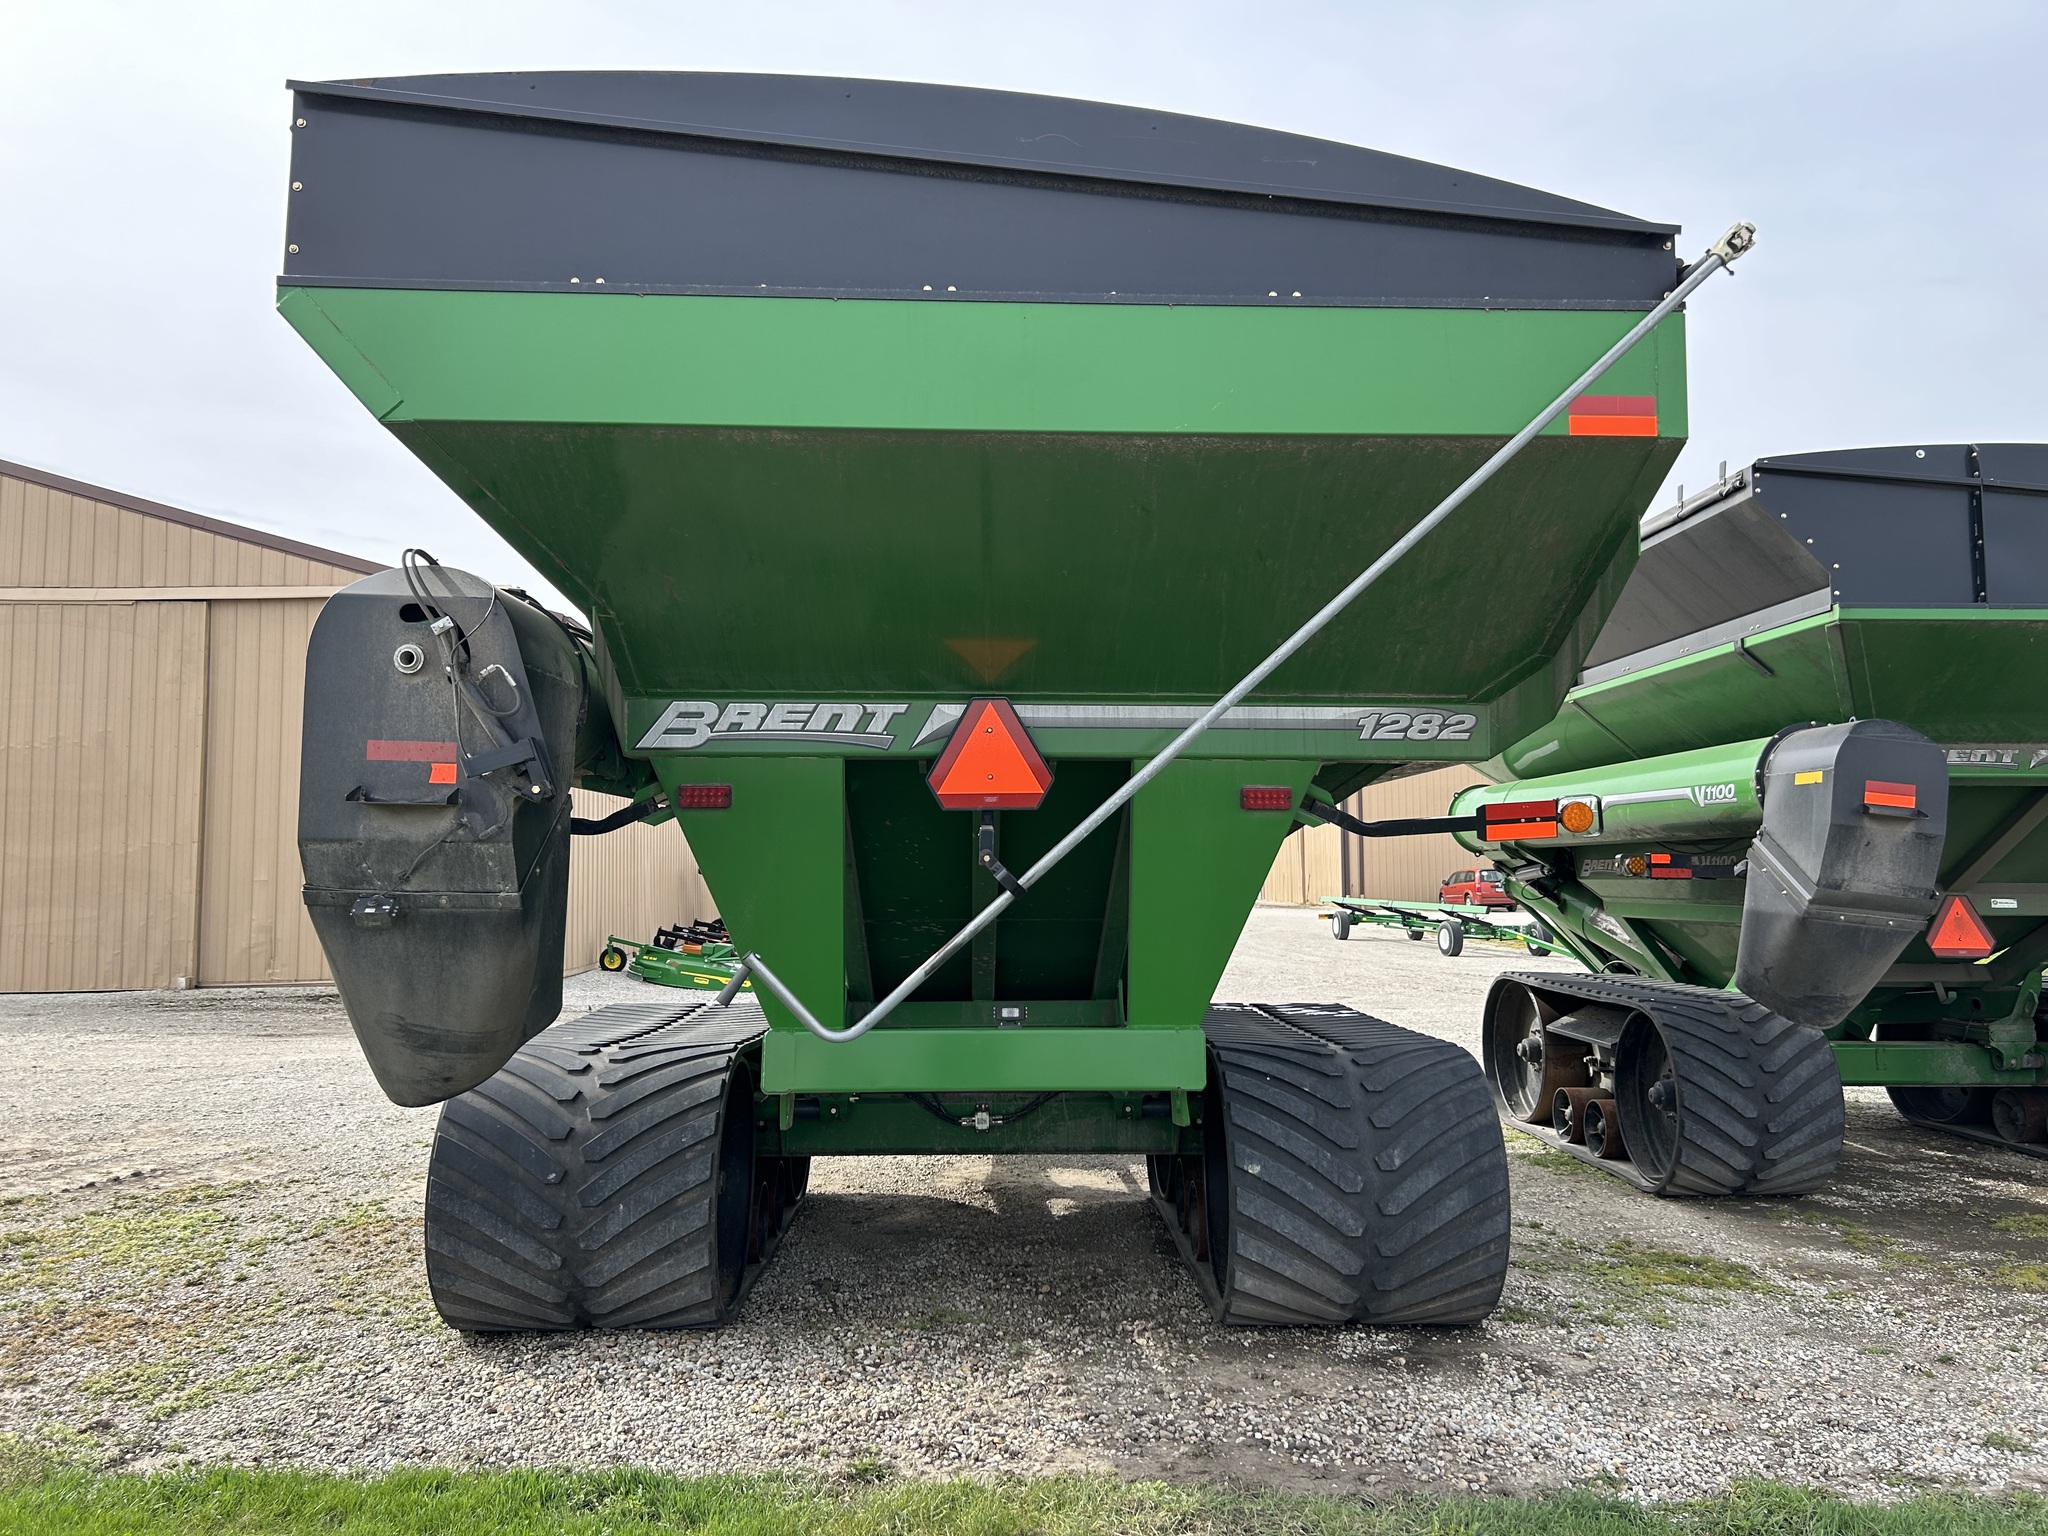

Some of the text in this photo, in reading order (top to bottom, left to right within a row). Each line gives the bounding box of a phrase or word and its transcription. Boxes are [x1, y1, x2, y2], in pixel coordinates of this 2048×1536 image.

[635, 700, 909, 748] BRENT
[1357, 712, 1477, 740] 1282
[1942, 749, 2018, 763] ENT
[1694, 783, 1736, 807] V1100
